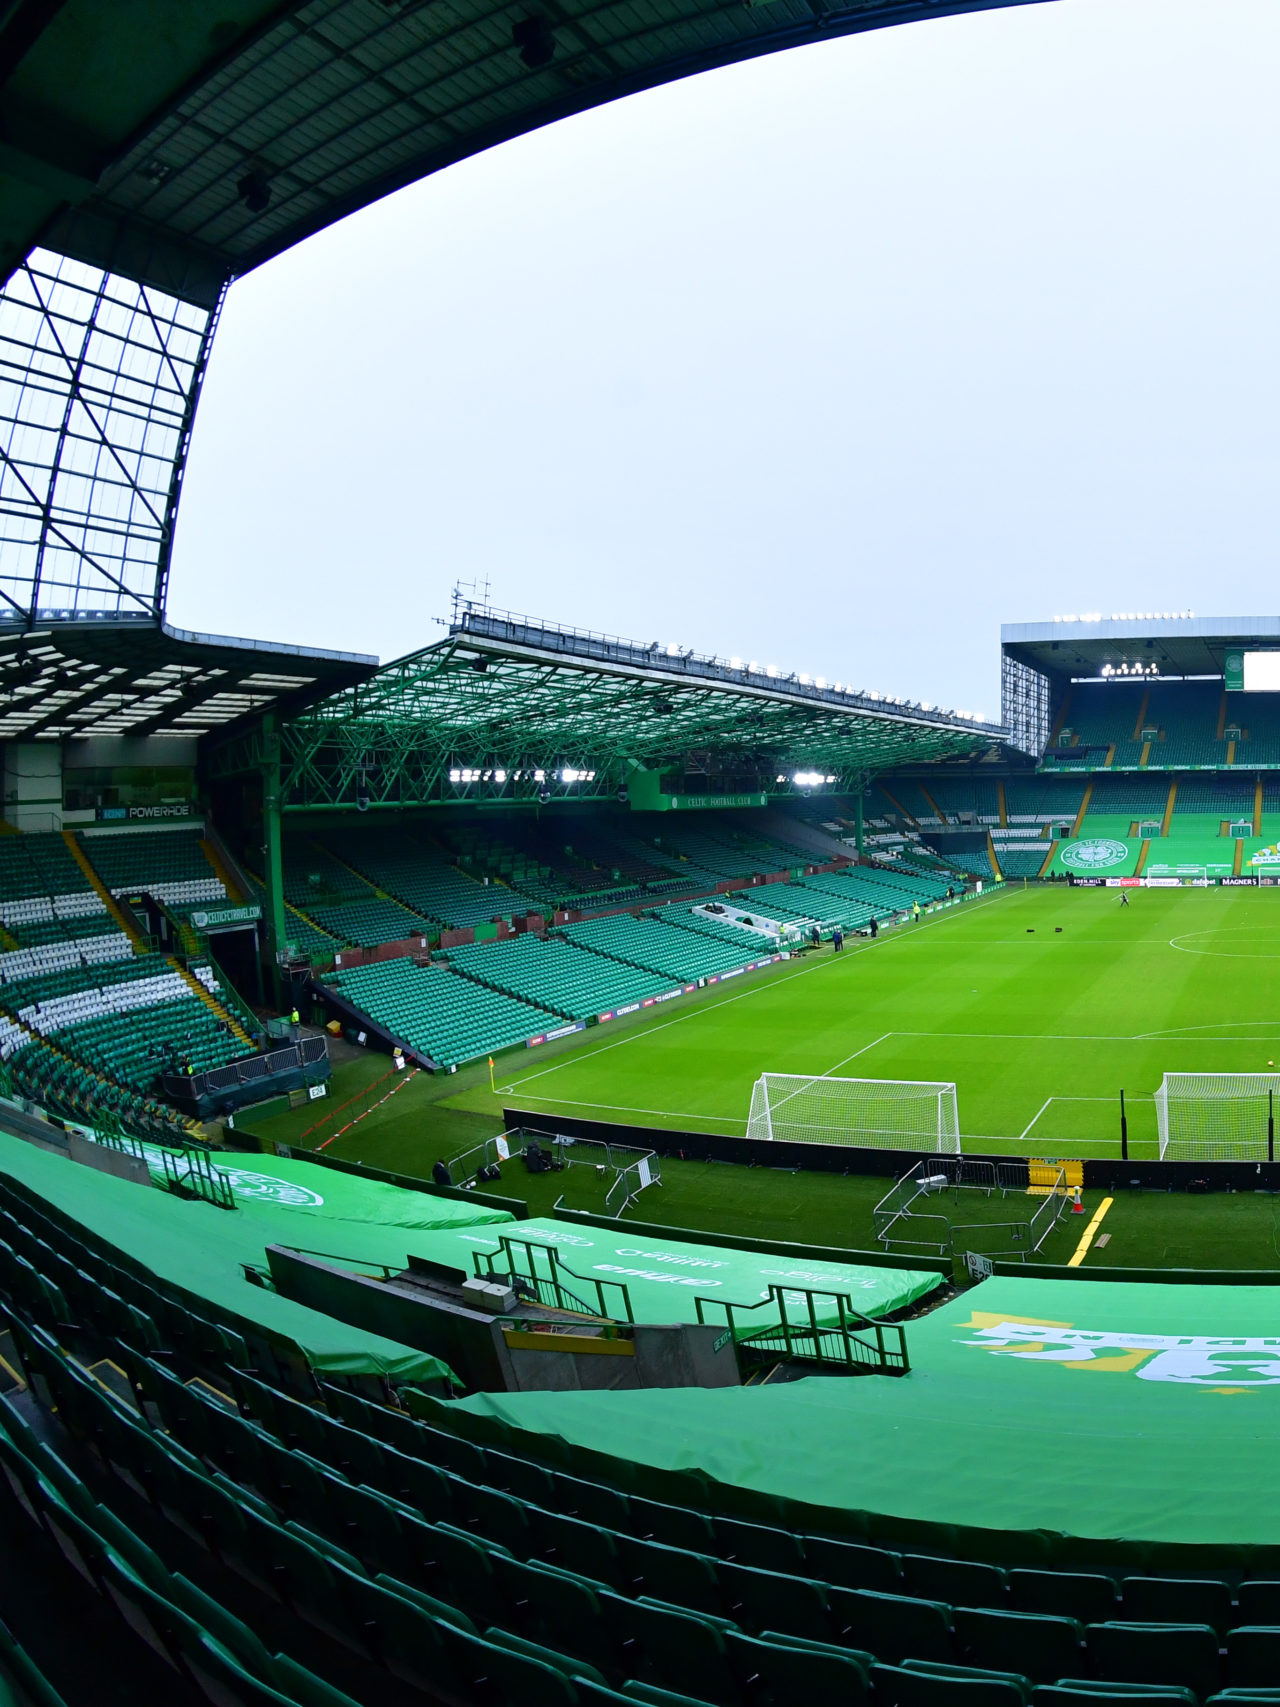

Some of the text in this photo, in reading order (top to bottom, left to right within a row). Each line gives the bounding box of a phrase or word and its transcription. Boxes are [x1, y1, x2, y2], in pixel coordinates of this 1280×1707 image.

[688, 796, 751, 807] CELTIC FOOTBALL CLUB
[129, 805, 190, 818] POWERADE
[1192, 878, 1216, 886] dafabet
[1222, 878, 1257, 886] MAGNERS
